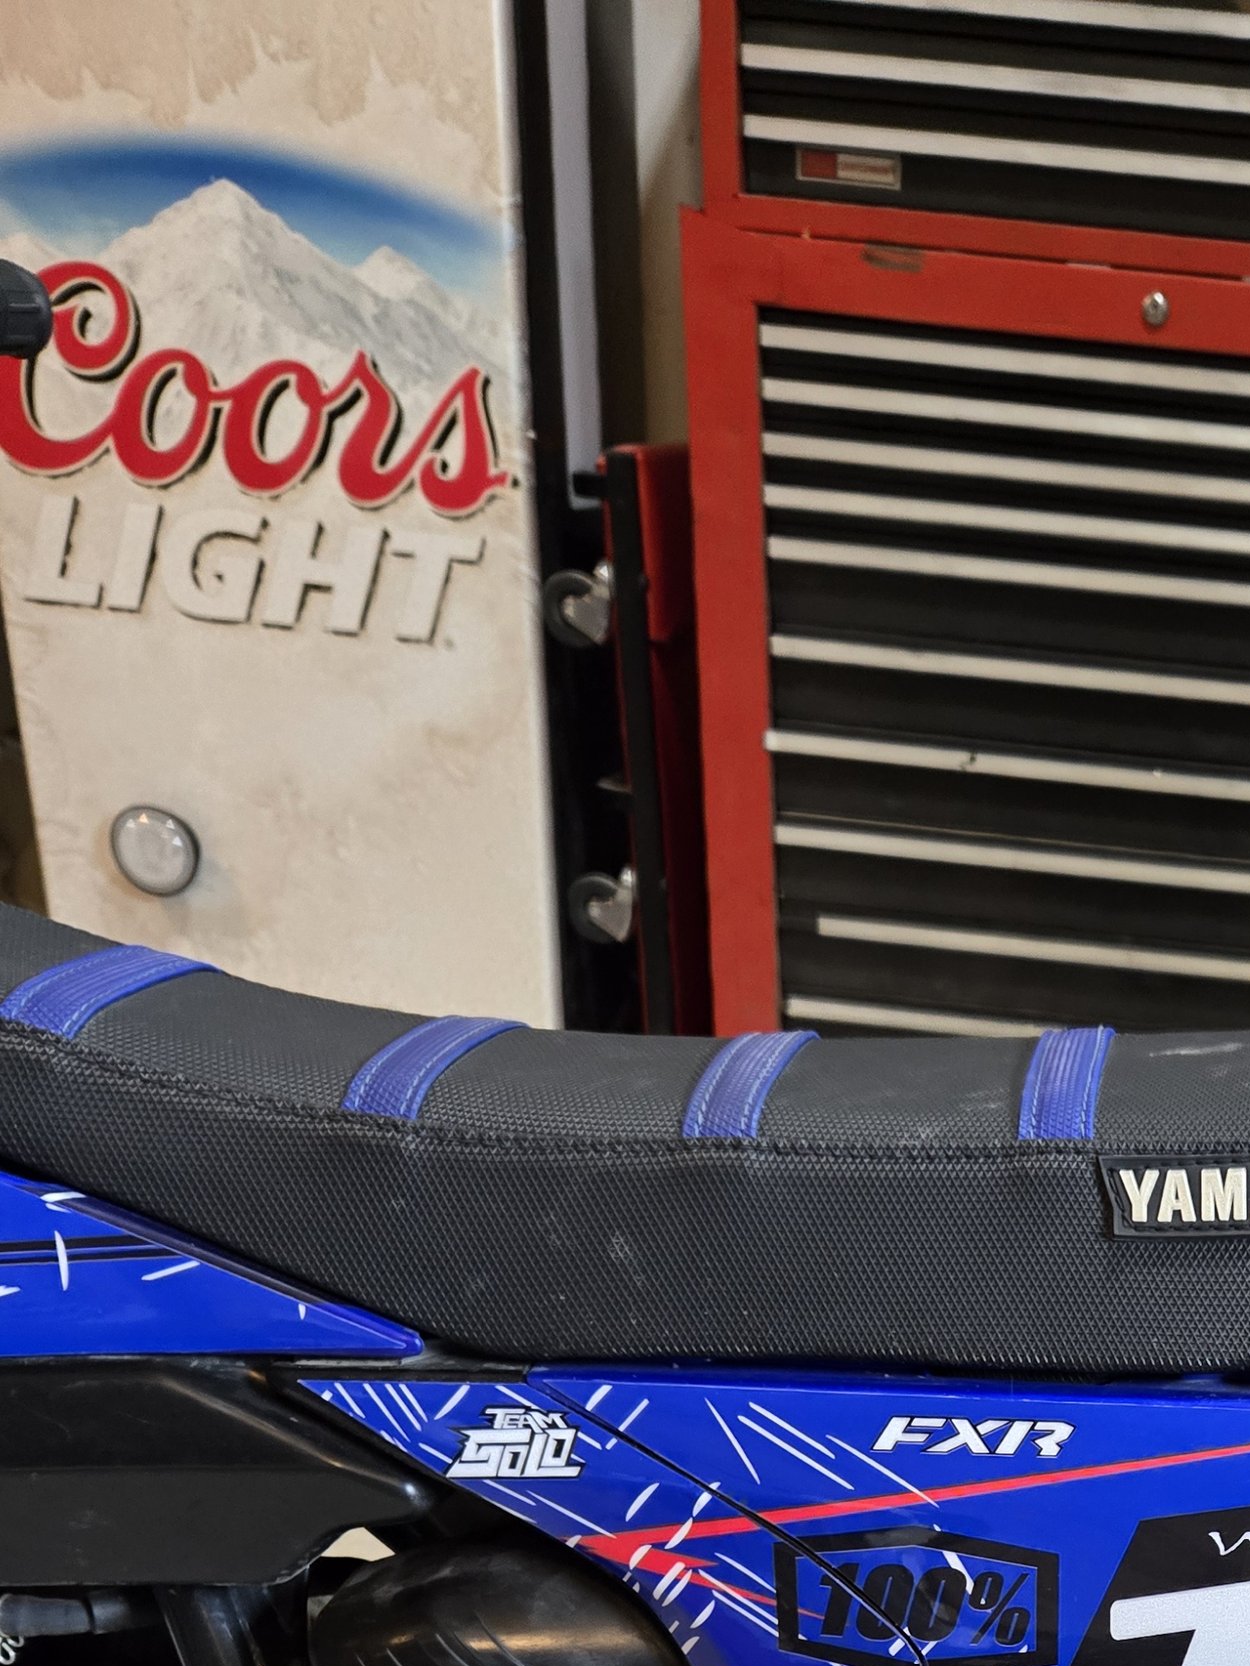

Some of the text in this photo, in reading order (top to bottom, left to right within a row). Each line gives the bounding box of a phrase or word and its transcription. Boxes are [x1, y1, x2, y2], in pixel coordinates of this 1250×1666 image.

[0, 260, 512, 520] Coors
[22, 496, 487, 644] LIGHT
[446, 1428, 582, 1478] SOLO
[484, 1406, 569, 1434] TEAM
[871, 1415, 1077, 1457] FXR
[818, 1562, 1031, 1647] 100%
